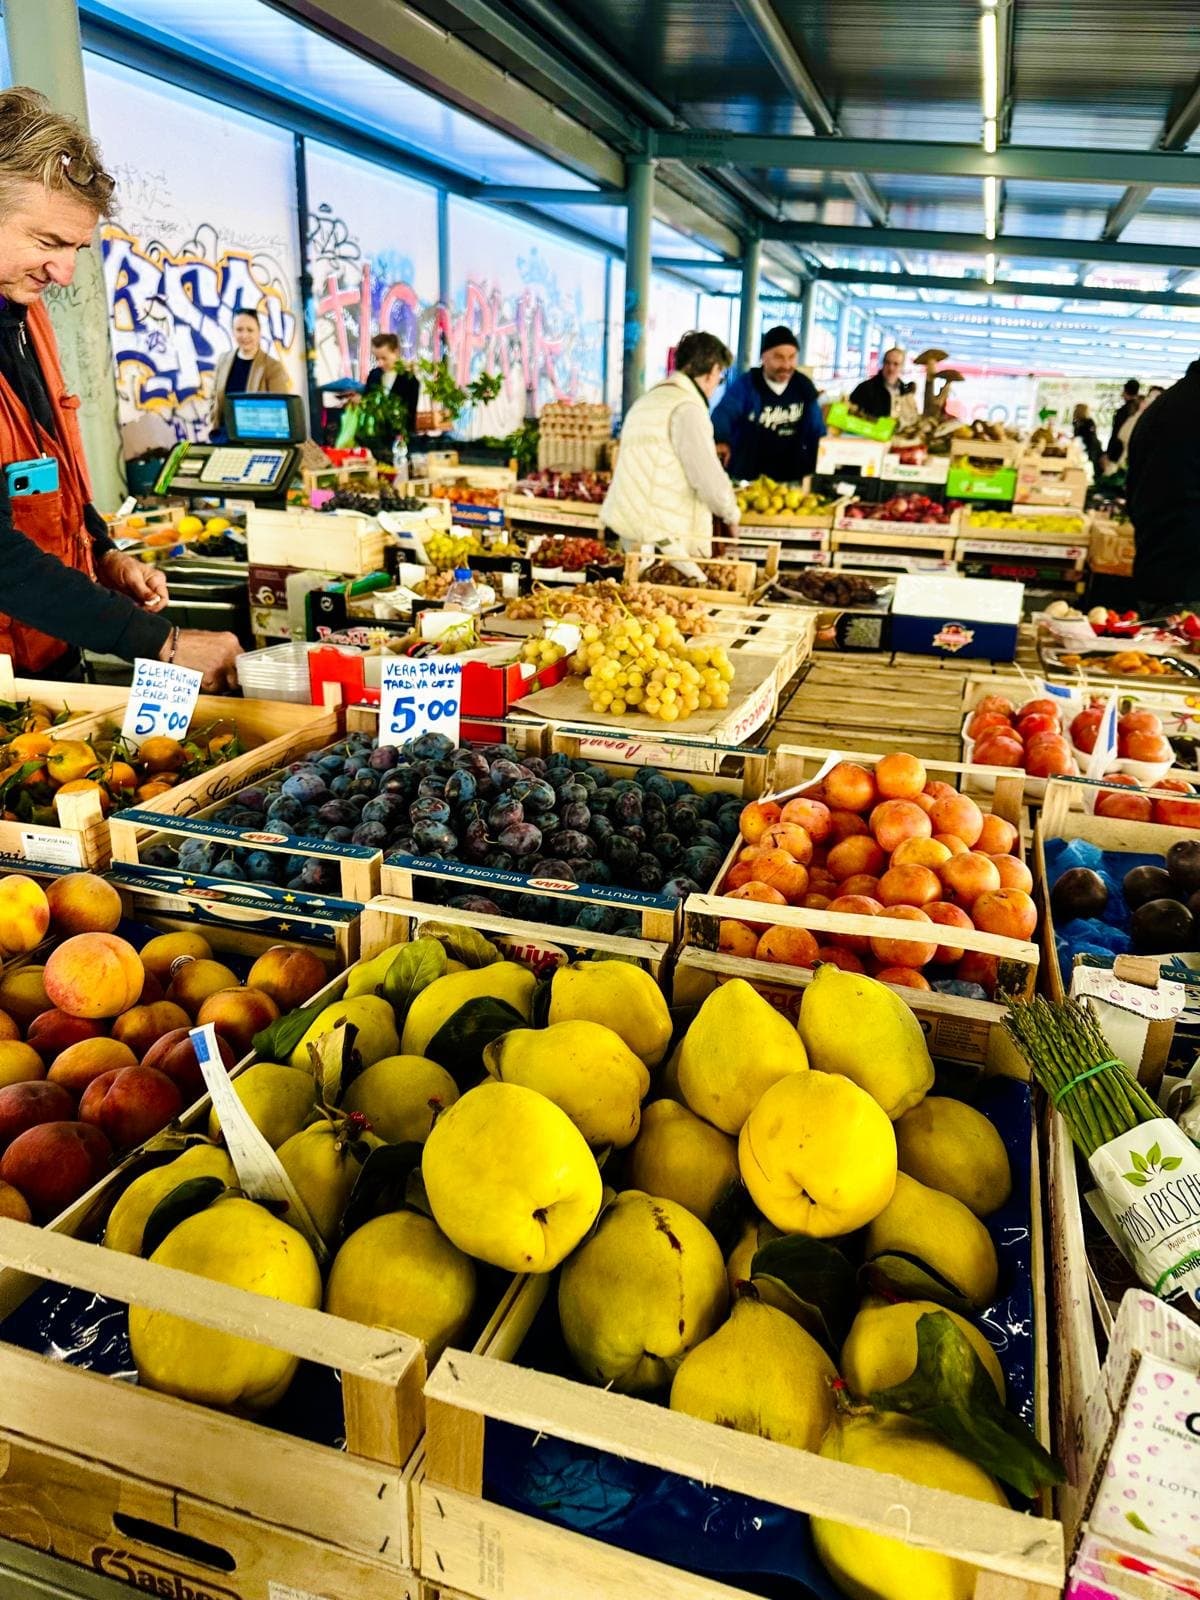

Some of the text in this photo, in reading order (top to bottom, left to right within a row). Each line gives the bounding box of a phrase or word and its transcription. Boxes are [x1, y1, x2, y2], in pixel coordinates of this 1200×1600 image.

[386, 663, 417, 677] VERA
[384, 679, 428, 691] TARDIVA
[164, 818, 186, 828] DAL
[187, 820, 238, 837] MIGLIORE
[298, 840, 339, 853] FRUTTA
[441, 863, 466, 874] DAL
[466, 867, 523, 883] MIGLIORE
[129, 877, 171, 891] FRUTTA
[591, 887, 657, 903] LA FRUTTA
[228, 895, 281, 910] MIGLIORE
